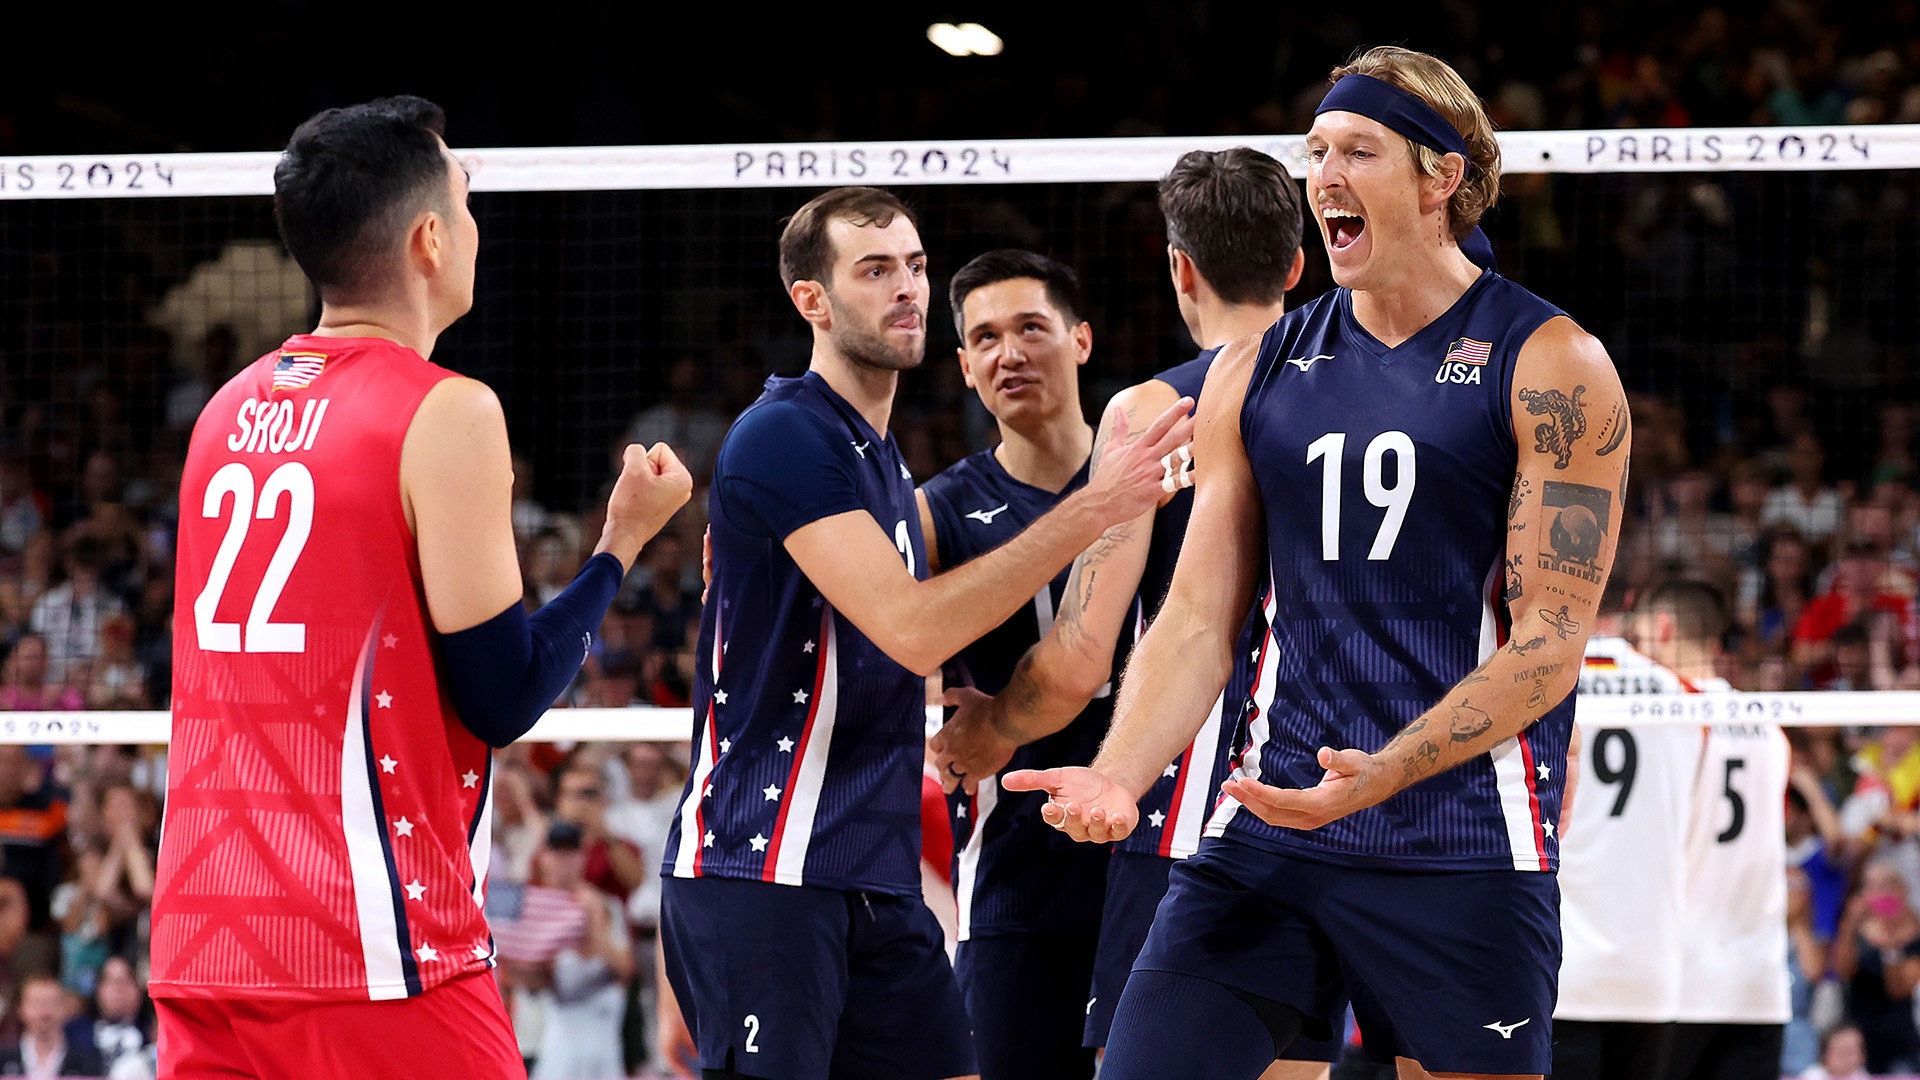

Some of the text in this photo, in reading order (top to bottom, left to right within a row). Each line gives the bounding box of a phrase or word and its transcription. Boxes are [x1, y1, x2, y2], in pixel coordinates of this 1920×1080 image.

[889, 148, 1010, 177] 2024
[1746, 133, 1870, 162] 2024
[57, 161, 173, 191] 2024
[1435, 362, 1480, 385] USA
[227, 398, 330, 454] SHOJI
[1306, 430, 1417, 561] 19
[194, 461, 315, 653] 22
[1545, 585, 1565, 596] YOU
[1514, 669, 1530, 683] PAY
[1592, 728, 1638, 818] 9
[1717, 758, 1745, 844] 5
[743, 1014, 760, 1054] 2
